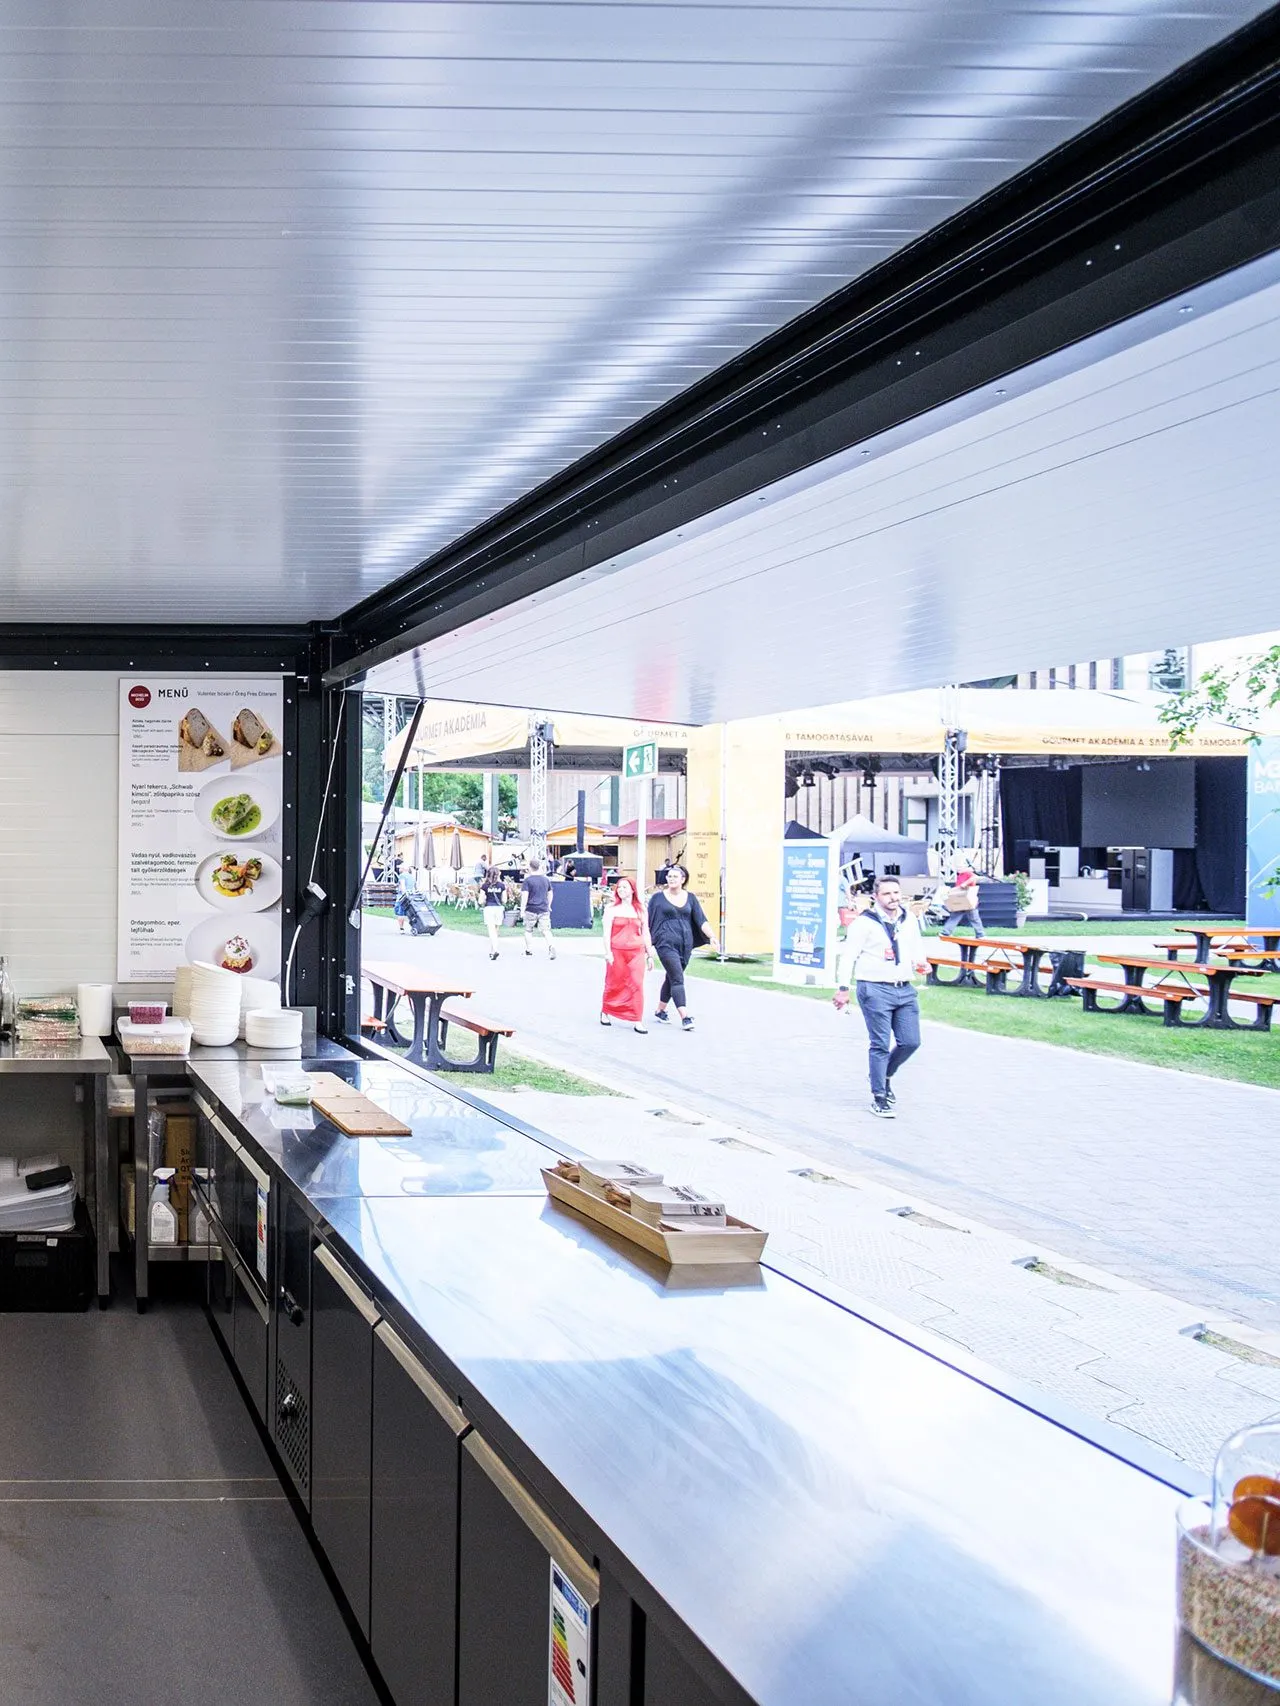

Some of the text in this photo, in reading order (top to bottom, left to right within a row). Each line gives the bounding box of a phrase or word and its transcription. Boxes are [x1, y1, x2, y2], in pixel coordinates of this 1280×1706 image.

[158, 687, 189, 698] MENÜ
[1042, 736, 1086, 744] GOURMET
[1088, 736, 1136, 746] AKADÉMIA
